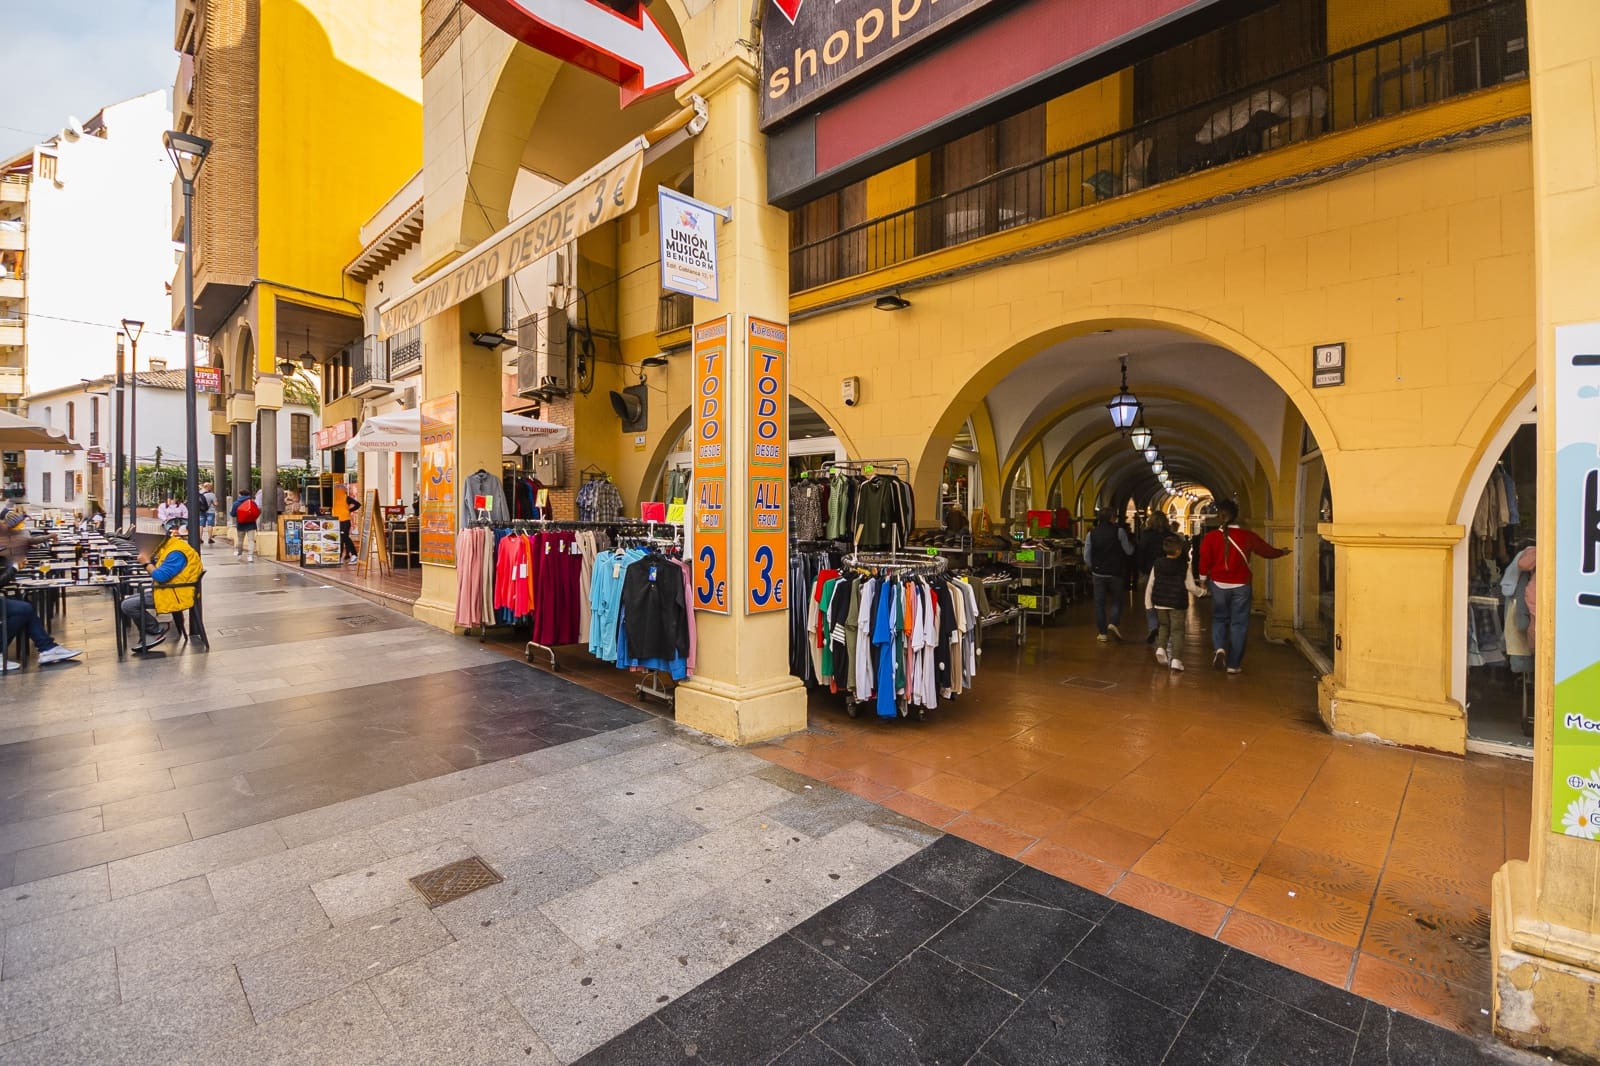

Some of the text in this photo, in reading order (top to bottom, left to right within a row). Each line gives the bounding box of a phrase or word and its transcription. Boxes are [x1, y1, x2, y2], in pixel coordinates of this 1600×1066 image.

[769, 0, 941, 99] shopp
[455, 253, 500, 300] TODO
[508, 200, 576, 276] DESDE
[588, 174, 606, 224] 3
[613, 175, 625, 207] €
[670, 229, 708, 250] UNIÓN
[666, 239, 713, 263] MUSICAL
[666, 252, 714, 270] BENIDORM
[195, 372, 218, 380] UPER
[702, 354, 719, 439] TODO
[758, 354, 778, 439] TODO
[700, 445, 720, 457] DESDE
[756, 444, 780, 457] DESDE
[700, 484, 721, 509] ALL
[755, 484, 780, 509] ALL
[758, 514, 777, 526] FROM
[697, 545, 724, 605] 3€
[752, 545, 783, 606] 3€
